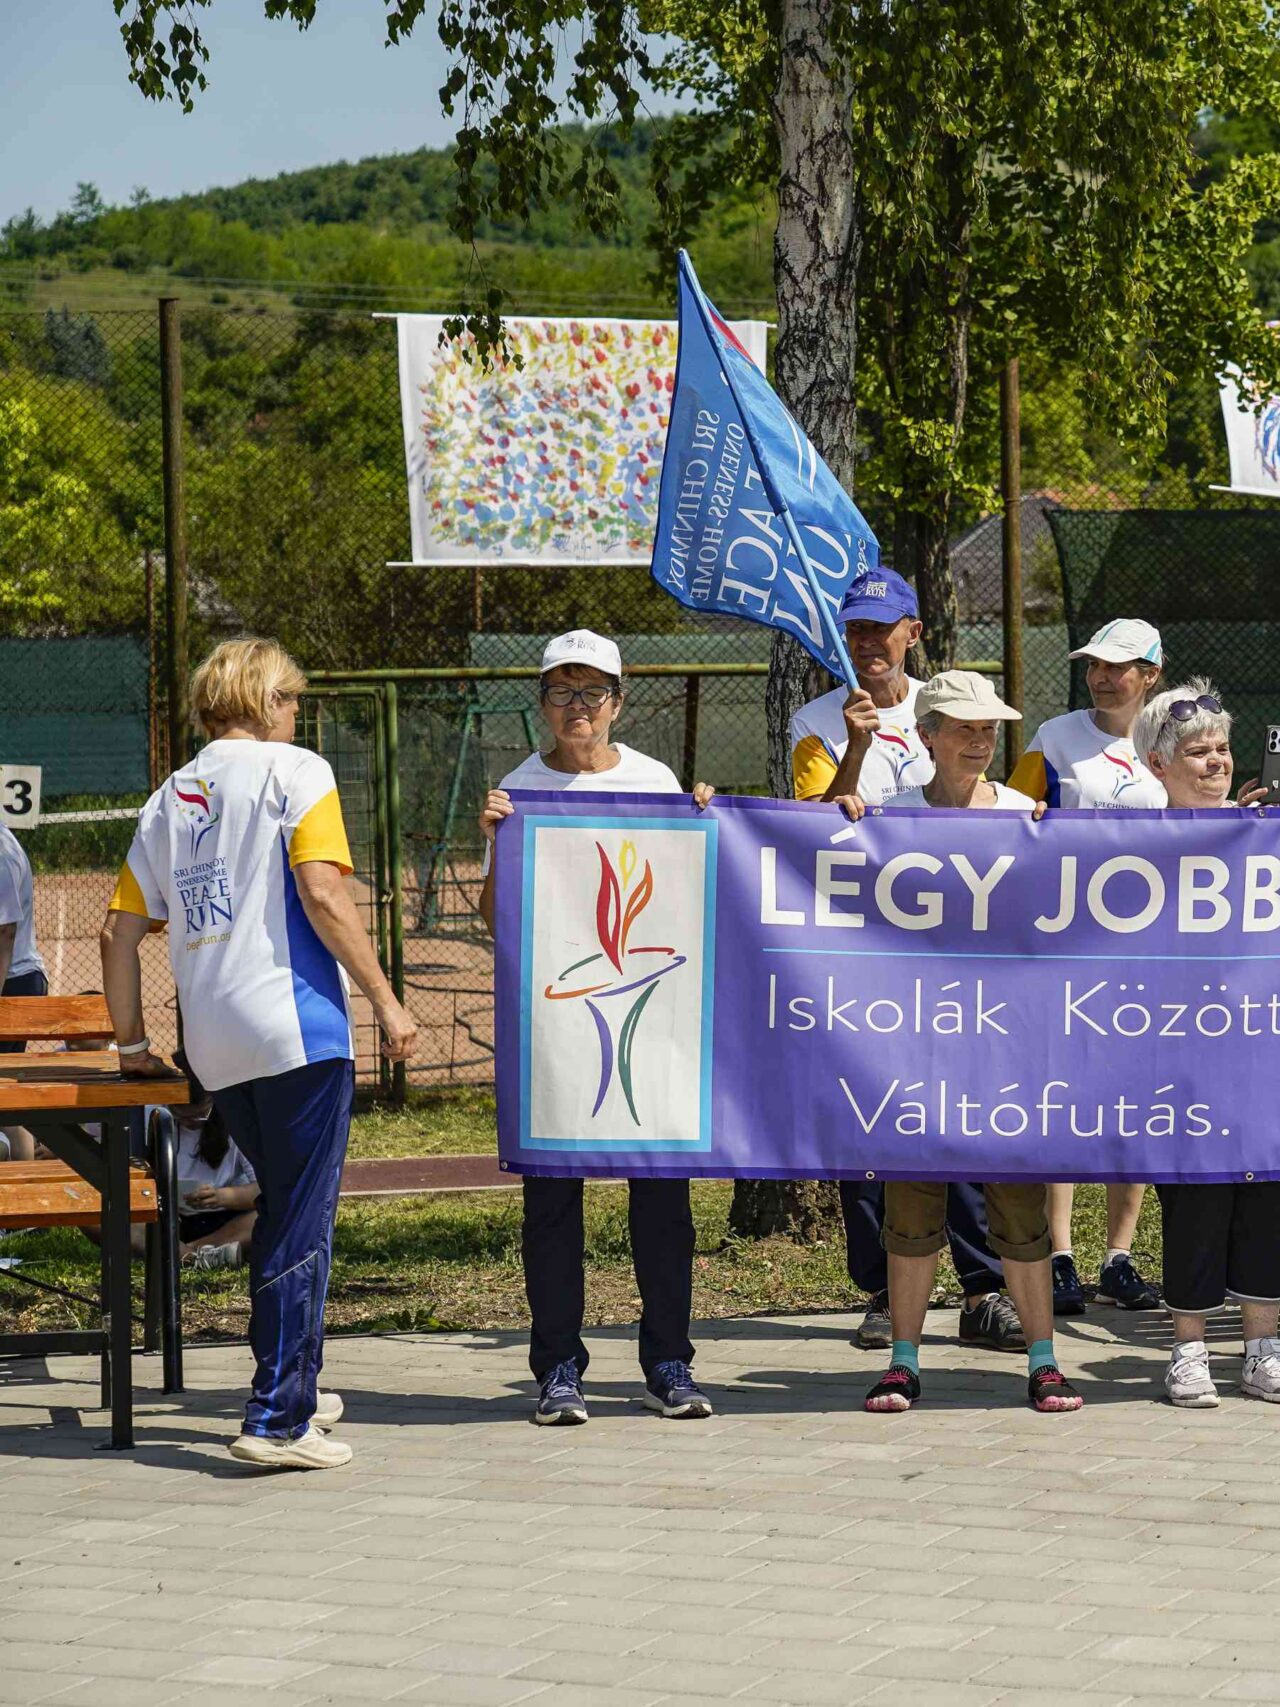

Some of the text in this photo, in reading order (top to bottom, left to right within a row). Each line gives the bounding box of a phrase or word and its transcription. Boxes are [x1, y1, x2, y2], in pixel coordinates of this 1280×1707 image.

[3, 780, 32, 815] 3
[190, 857, 226, 875] CHINOY
[760, 826, 1016, 931] LÉGY
[178, 878, 231, 907] PEACE
[768, 974, 1009, 1035] Iskolák
[838, 1077, 1231, 1137] Váltófutás.
